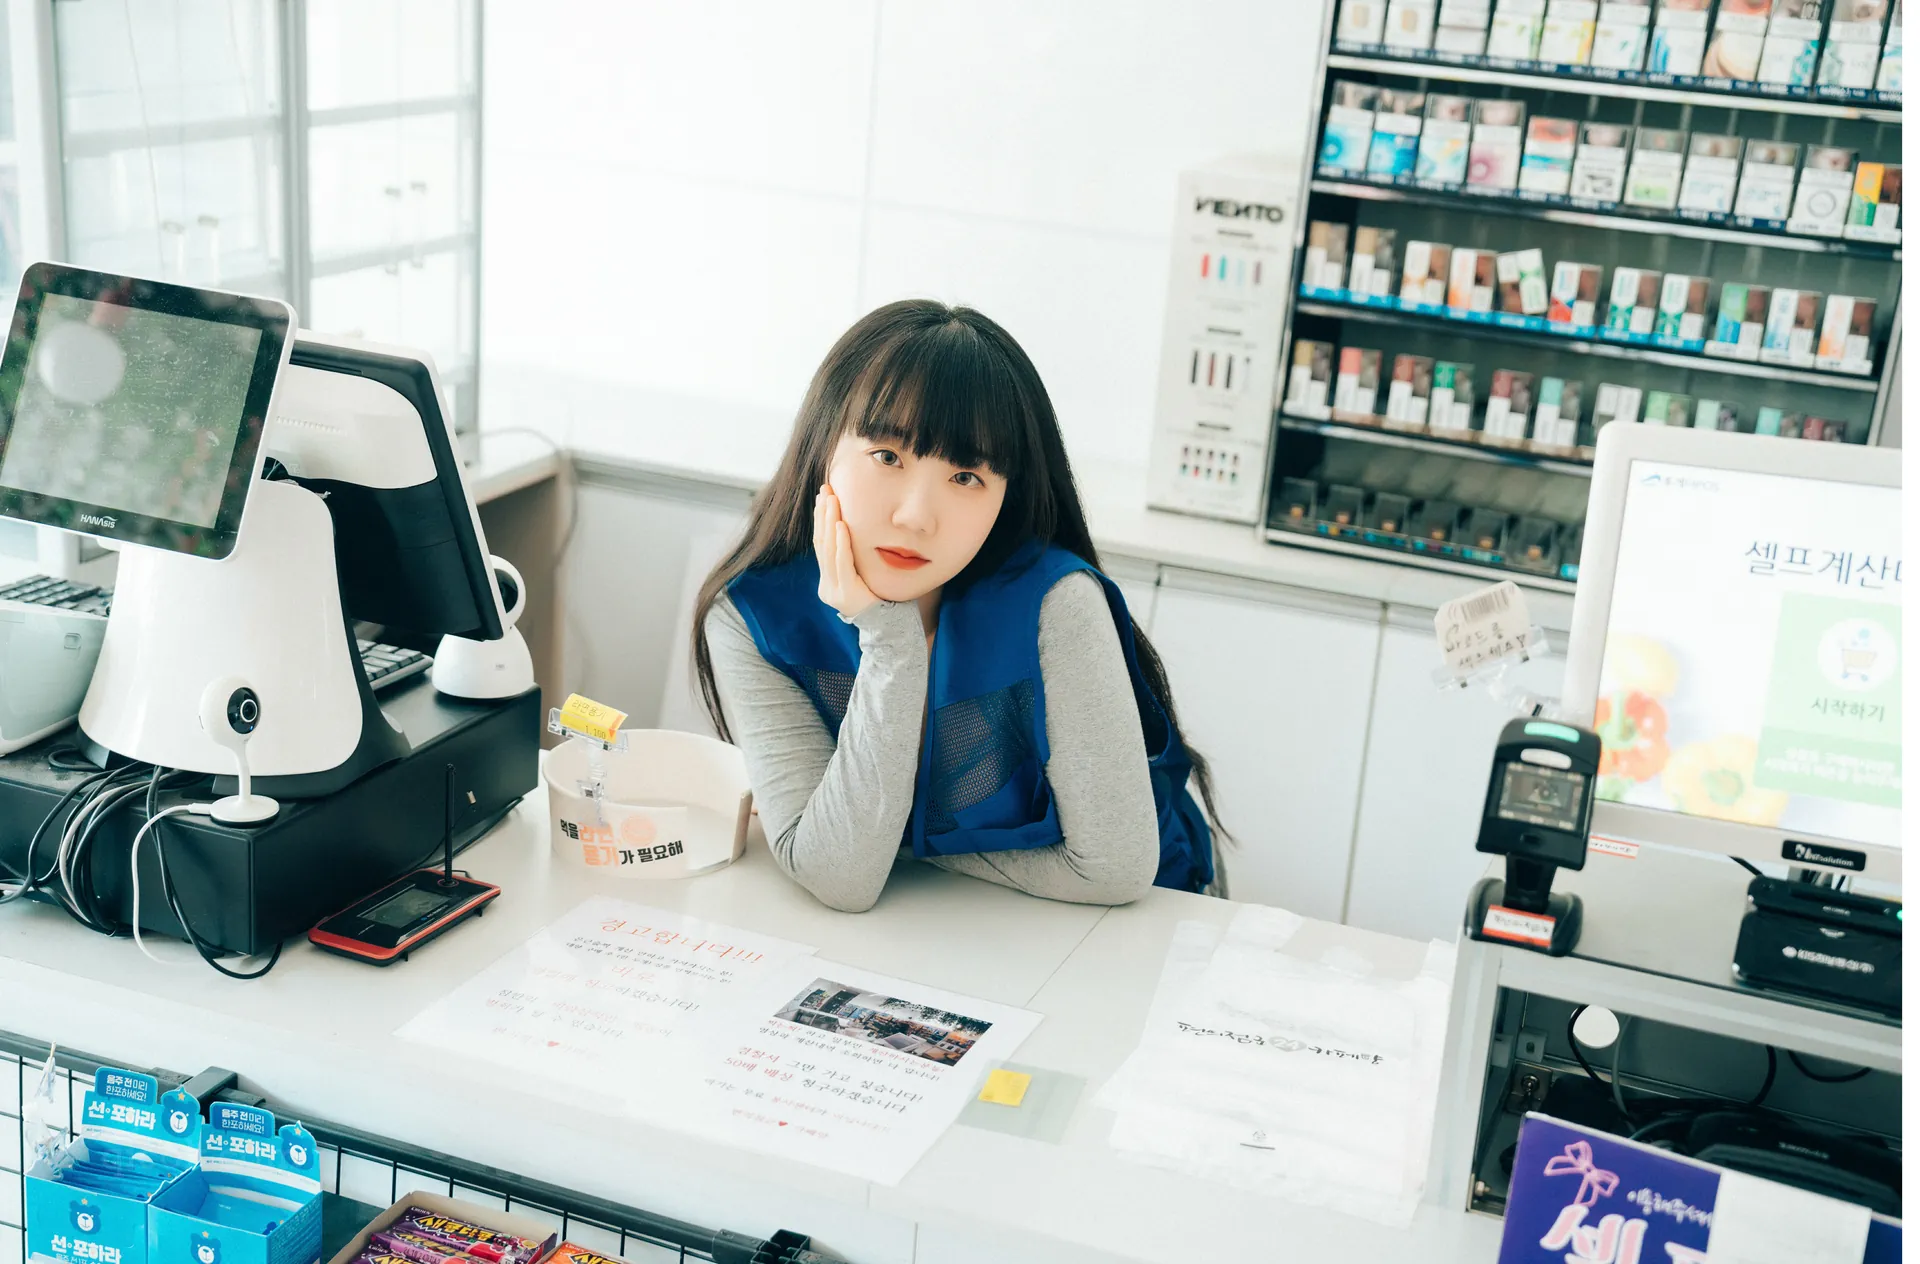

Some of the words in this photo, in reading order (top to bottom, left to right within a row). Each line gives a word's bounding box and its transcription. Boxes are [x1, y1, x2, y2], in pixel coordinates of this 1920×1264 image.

[1744, 541, 1902, 589] 셀프계산
[571, 699, 607, 720] 라면용기
[1811, 696, 1885, 723] 시작하기
[637, 840, 684, 863] 필요해
[600, 917, 765, 964] 경고합니다!!!
[106, 1074, 123, 1085] 음주
[723, 1056, 757, 1073] 50배
[762, 1066, 795, 1083] 배상
[799, 1077, 908, 1114] 청구하겠습니다
[785, 1058, 817, 1072] 그만
[820, 1067, 852, 1084] 가고
[860, 1078, 925, 1104] 싶습니다!
[105, 1084, 147, 1102] 한포하세요!
[221, 1108, 239, 1120] 음주
[221, 1118, 265, 1134] 한포하세요!
[418, 1215, 497, 1242] 새콤달콤
